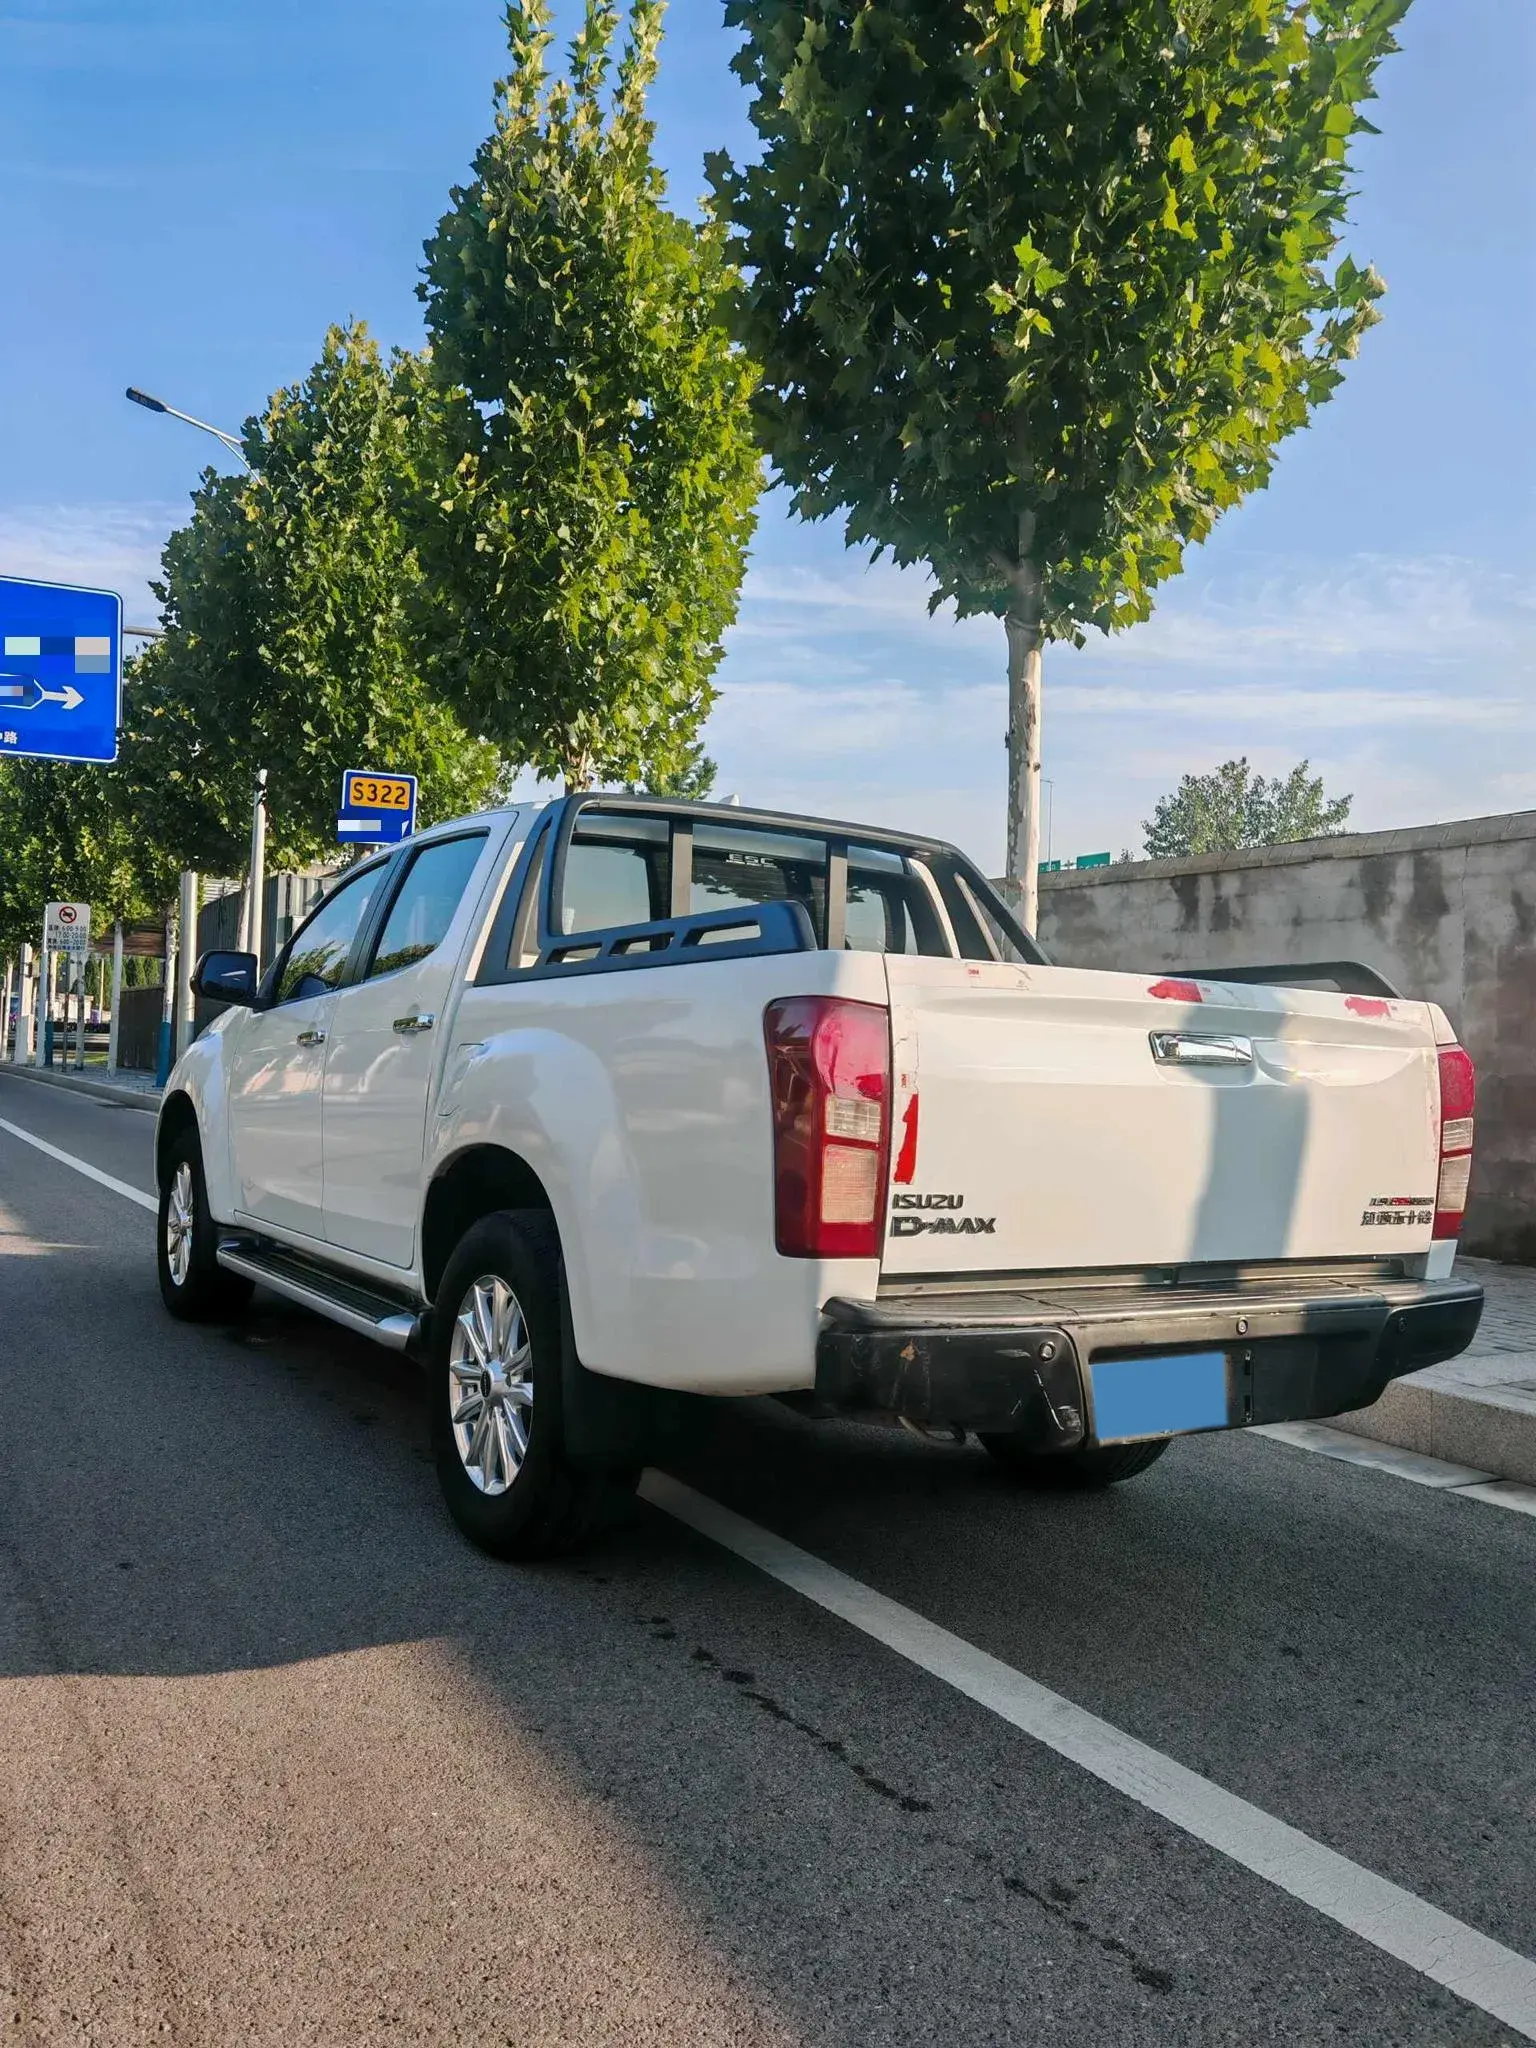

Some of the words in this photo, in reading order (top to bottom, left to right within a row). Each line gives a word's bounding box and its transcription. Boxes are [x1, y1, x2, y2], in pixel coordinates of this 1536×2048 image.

[0, 731, 18, 744] 路
[353, 782, 406, 805] S322
[892, 1194, 964, 1209] ISUZU
[890, 1216, 997, 1237] D-MAX
